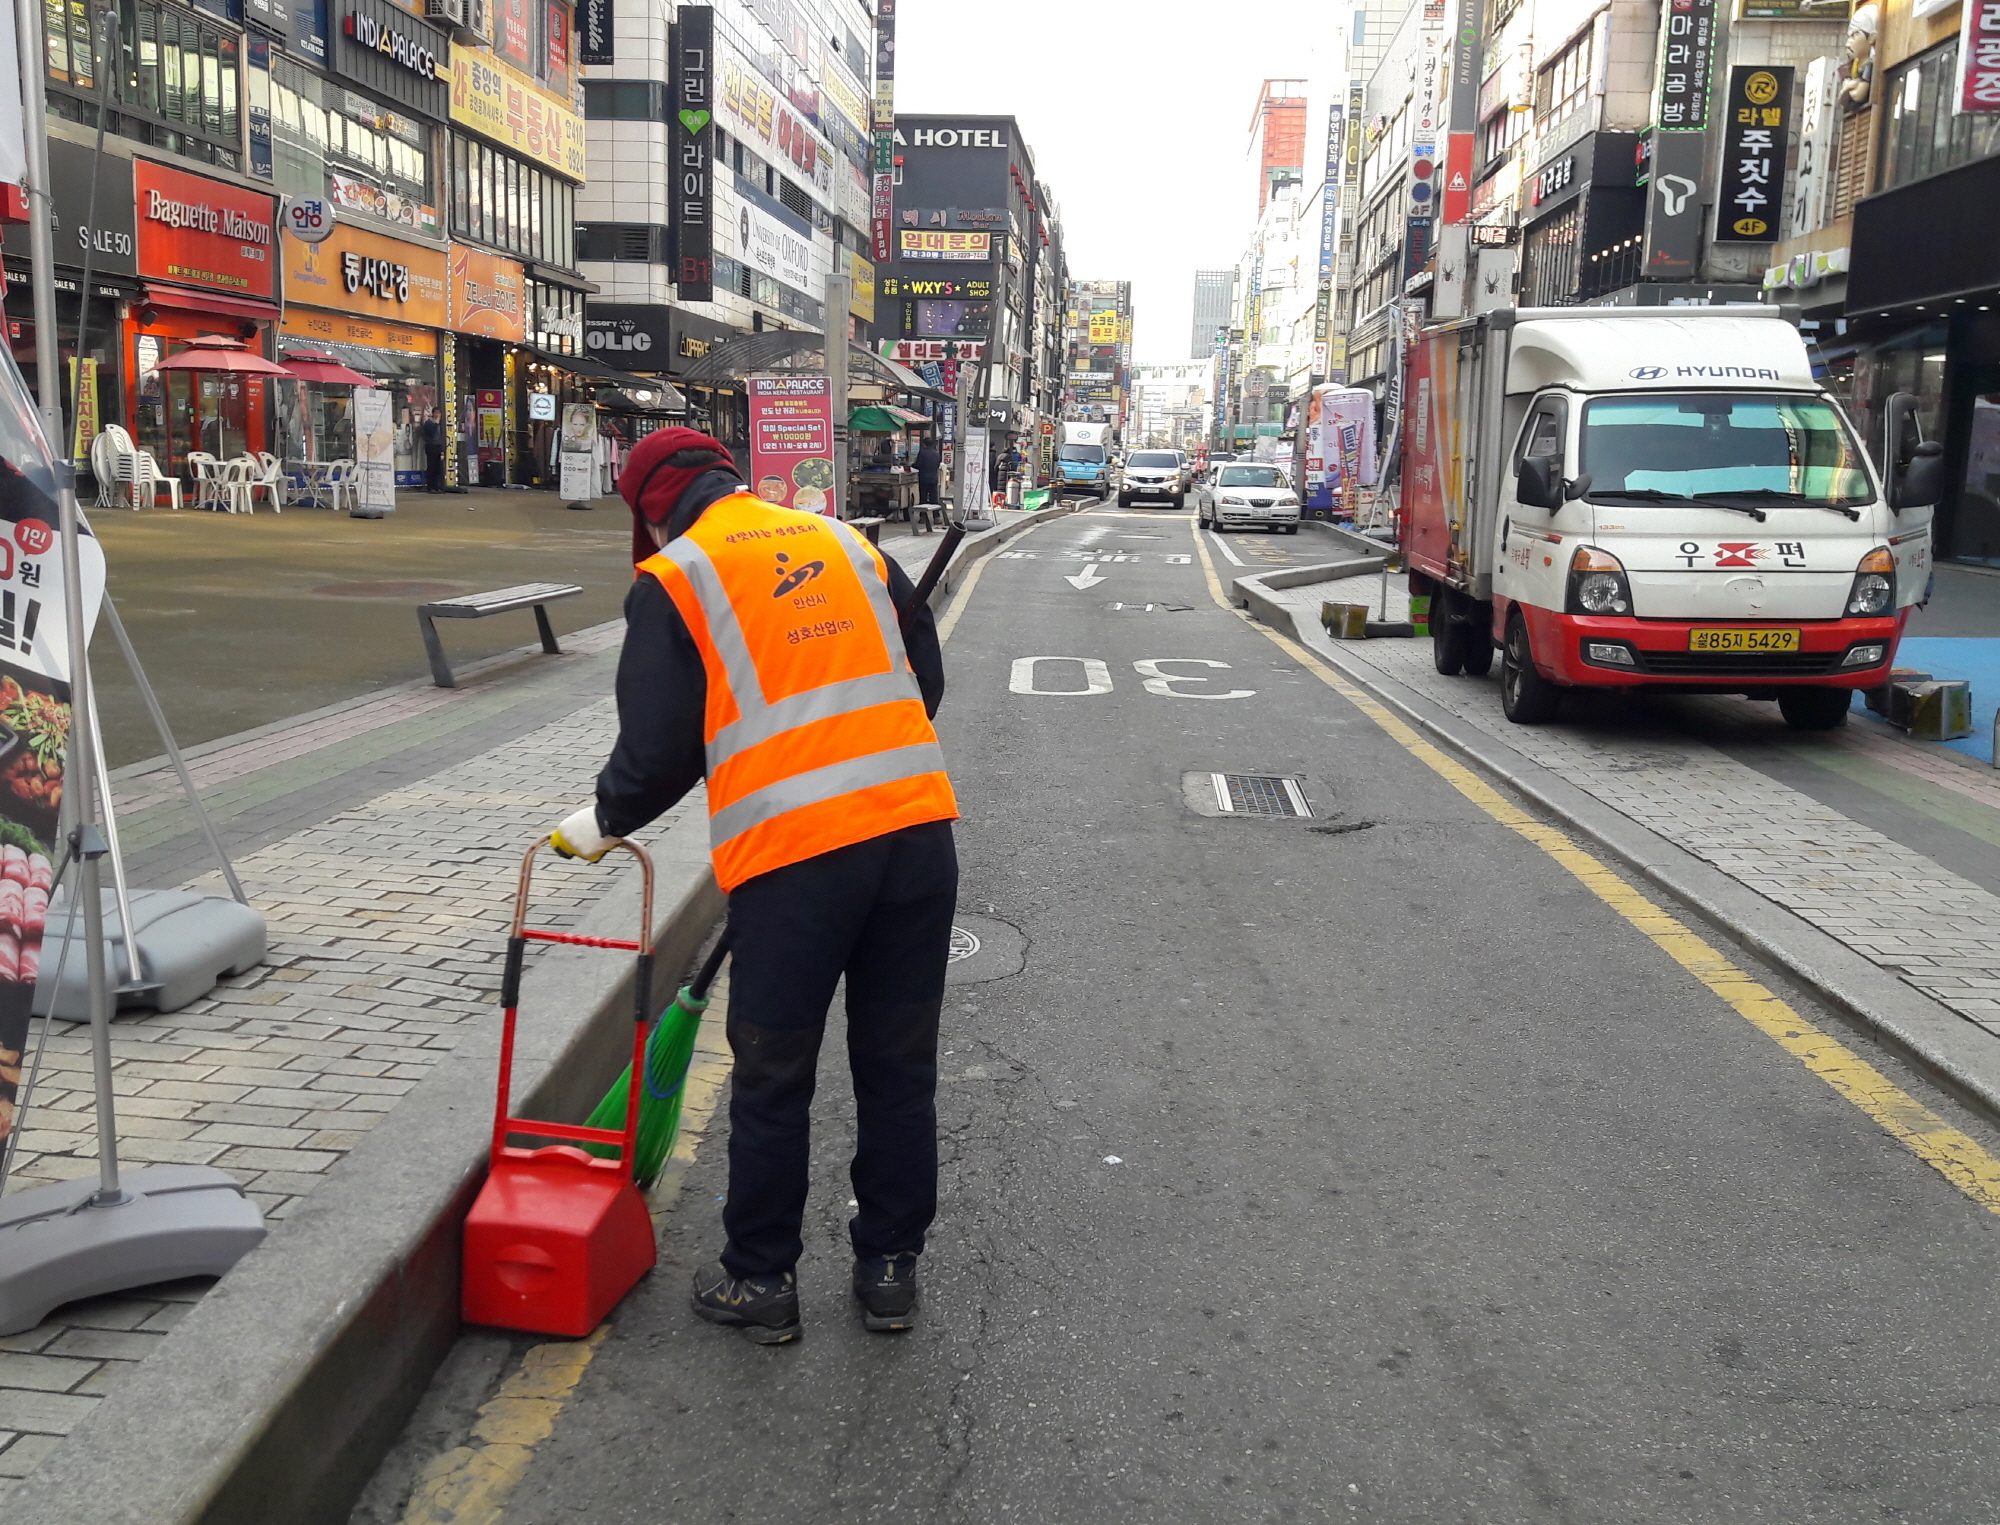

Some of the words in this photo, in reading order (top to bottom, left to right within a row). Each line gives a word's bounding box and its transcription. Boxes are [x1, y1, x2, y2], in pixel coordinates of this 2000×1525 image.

[391, 31, 434, 81] PALACE
[1461, 46, 1472, 84] YOUNG
[684, 49, 704, 102] 그린
[1663, 15, 1694, 122] 마라공방
[453, 58, 468, 109] 2F
[471, 60, 502, 103] 중앙역
[724, 57, 775, 145] 핸드폰
[506, 82, 562, 165] 부동산
[686, 115, 701, 125] ON
[571, 119, 584, 149] 410
[914, 128, 1008, 148] HOTEL
[683, 141, 704, 224] 라이트
[1733, 129, 1774, 213] 주짓수
[149, 188, 218, 233] Baguette
[221, 208, 271, 245] Maison
[876, 208, 888, 218] 5F
[1411, 205, 1431, 216] 4F
[1740, 221, 1761, 232] 4F
[79, 226, 113, 254] SALE
[115, 232, 132, 256] 50
[781, 233, 809, 272] OXFORD
[904, 232, 989, 250] 임대문의
[19, 273, 27, 284] 50
[344, 251, 409, 303] 동서안경
[682, 257, 710, 283] B1
[54, 279, 69, 289] SALE
[68, 281, 76, 291] 50
[100, 286, 113, 296] SALE
[911, 281, 953, 295] WXY'S
[1091, 317, 1115, 325] 스크린
[897, 343, 943, 358] 엘리트
[786, 380, 824, 390] PALACE
[1676, 366, 1780, 381] HYUNDAI
[778, 424, 806, 433] Special
[807, 423, 821, 431] Set
[1043, 424, 1052, 434] P
[22, 526, 48, 549] 1인
[793, 594, 828, 610] 안산시
[786, 619, 855, 645] 성호산업(주)
[1747, 633, 1793, 649] 5429
[1008, 655, 1257, 700] 30
